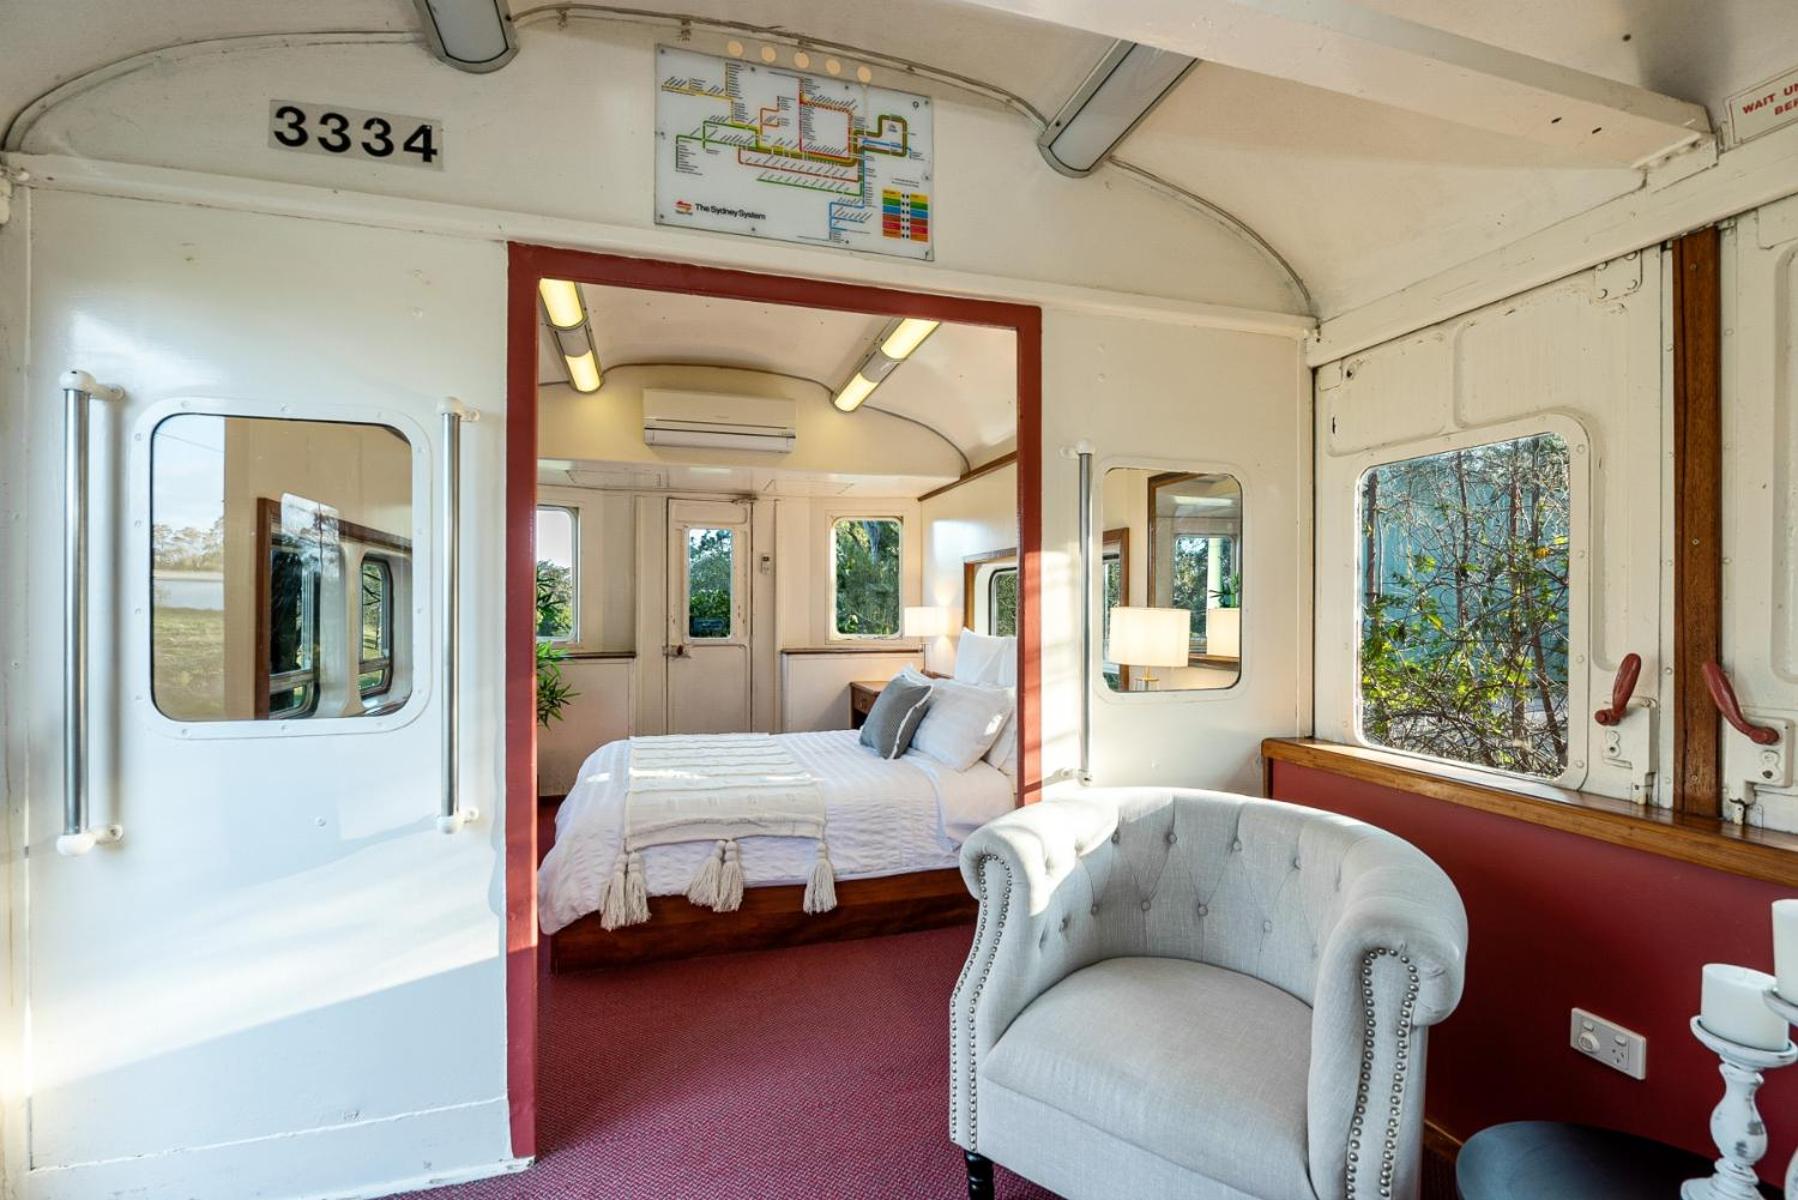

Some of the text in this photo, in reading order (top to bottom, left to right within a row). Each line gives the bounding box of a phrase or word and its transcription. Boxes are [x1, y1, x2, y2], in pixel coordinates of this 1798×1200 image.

[1743, 93, 1776, 114] WAIT
[274, 106, 438, 163] 3334
[695, 203, 710, 212] The
[711, 206, 738, 217] Sydney
[738, 209, 766, 220] System
